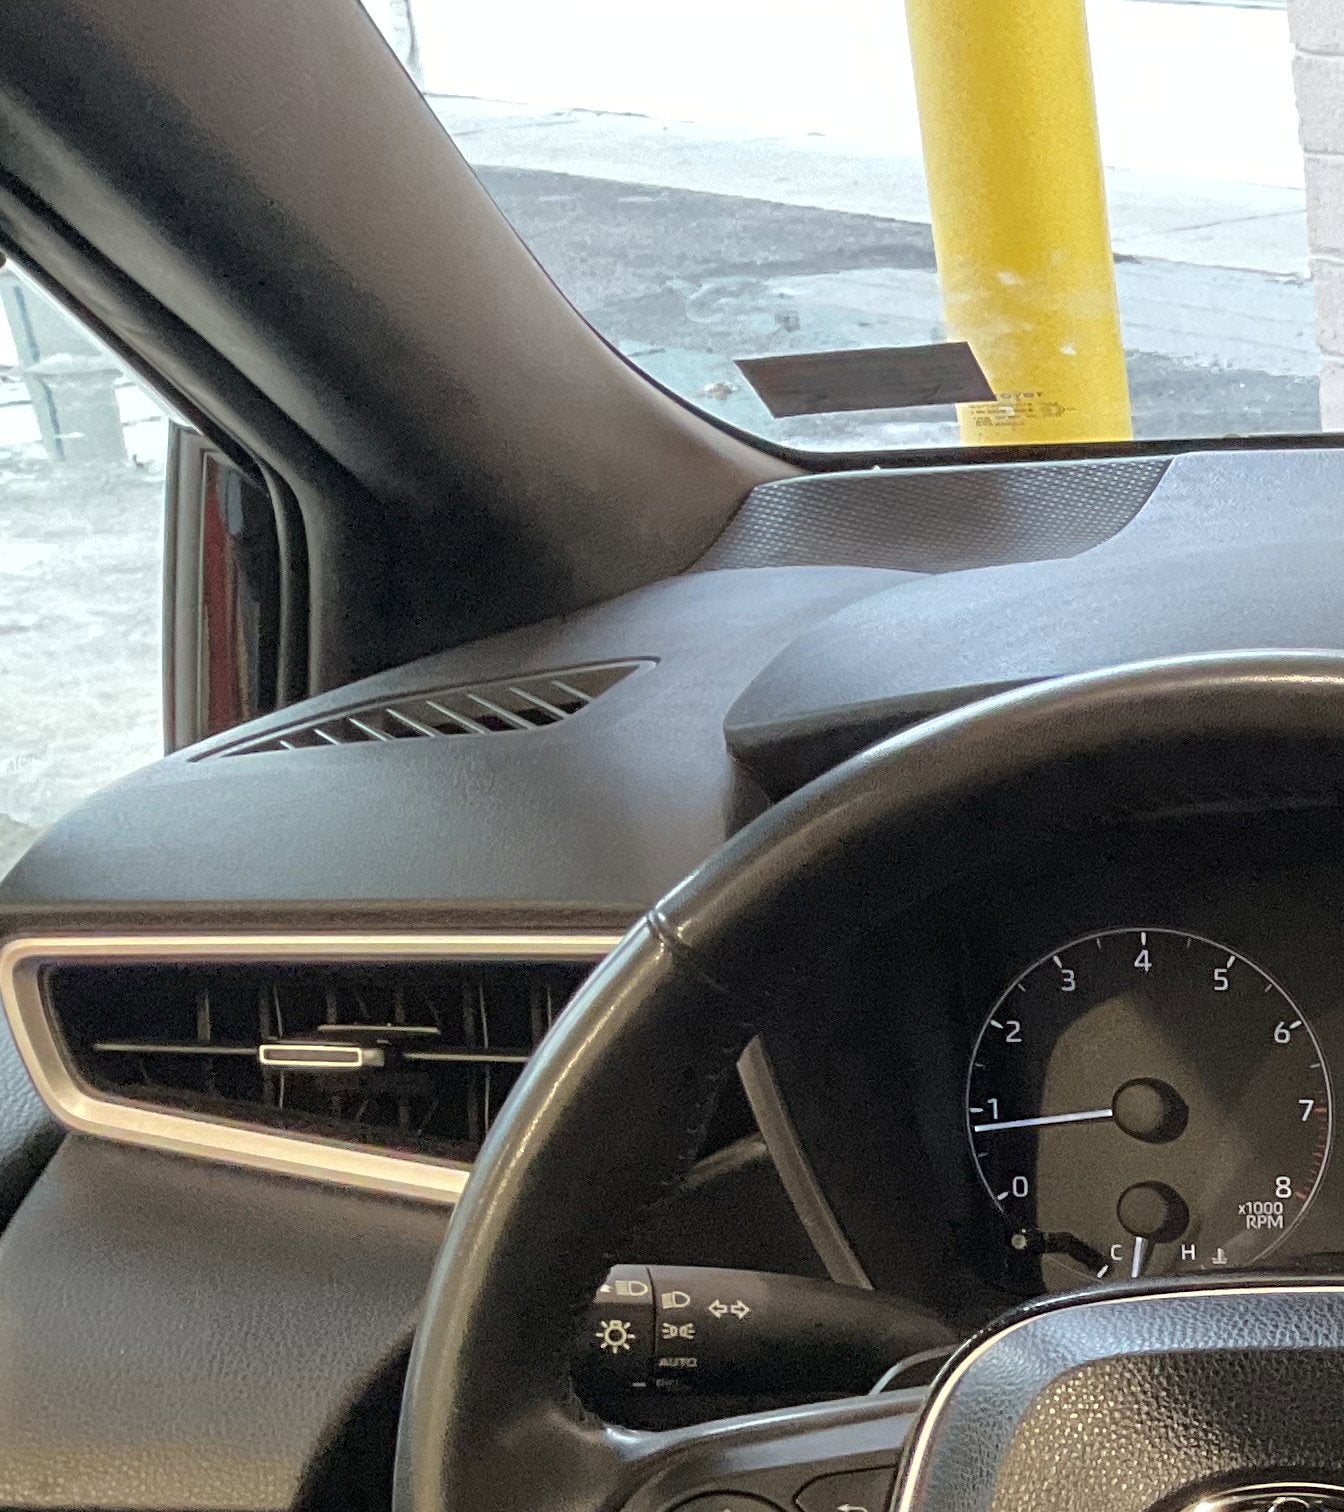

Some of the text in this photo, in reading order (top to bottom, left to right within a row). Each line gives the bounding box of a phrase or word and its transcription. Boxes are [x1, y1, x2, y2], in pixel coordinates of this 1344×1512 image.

[1135, 949, 1151, 972] 4
[1061, 969, 1076, 992] 3
[1213, 968, 1229, 991] 5
[1005, 1021, 1022, 1043] 2
[1273, 1022, 1290, 1045] 6
[987, 1098, 999, 1121] 1
[1298, 1099, 1315, 1122] 7
[1012, 1176, 1029, 1198] 0
[1275, 1176, 1292, 1198] 8
[1238, 1201, 1284, 1215] x1000
[1245, 1215, 1284, 1229] RPM
[1110, 1244, 1123, 1260] C
[1181, 1244, 1196, 1260] H
[658, 1356, 698, 1368] AUTO
